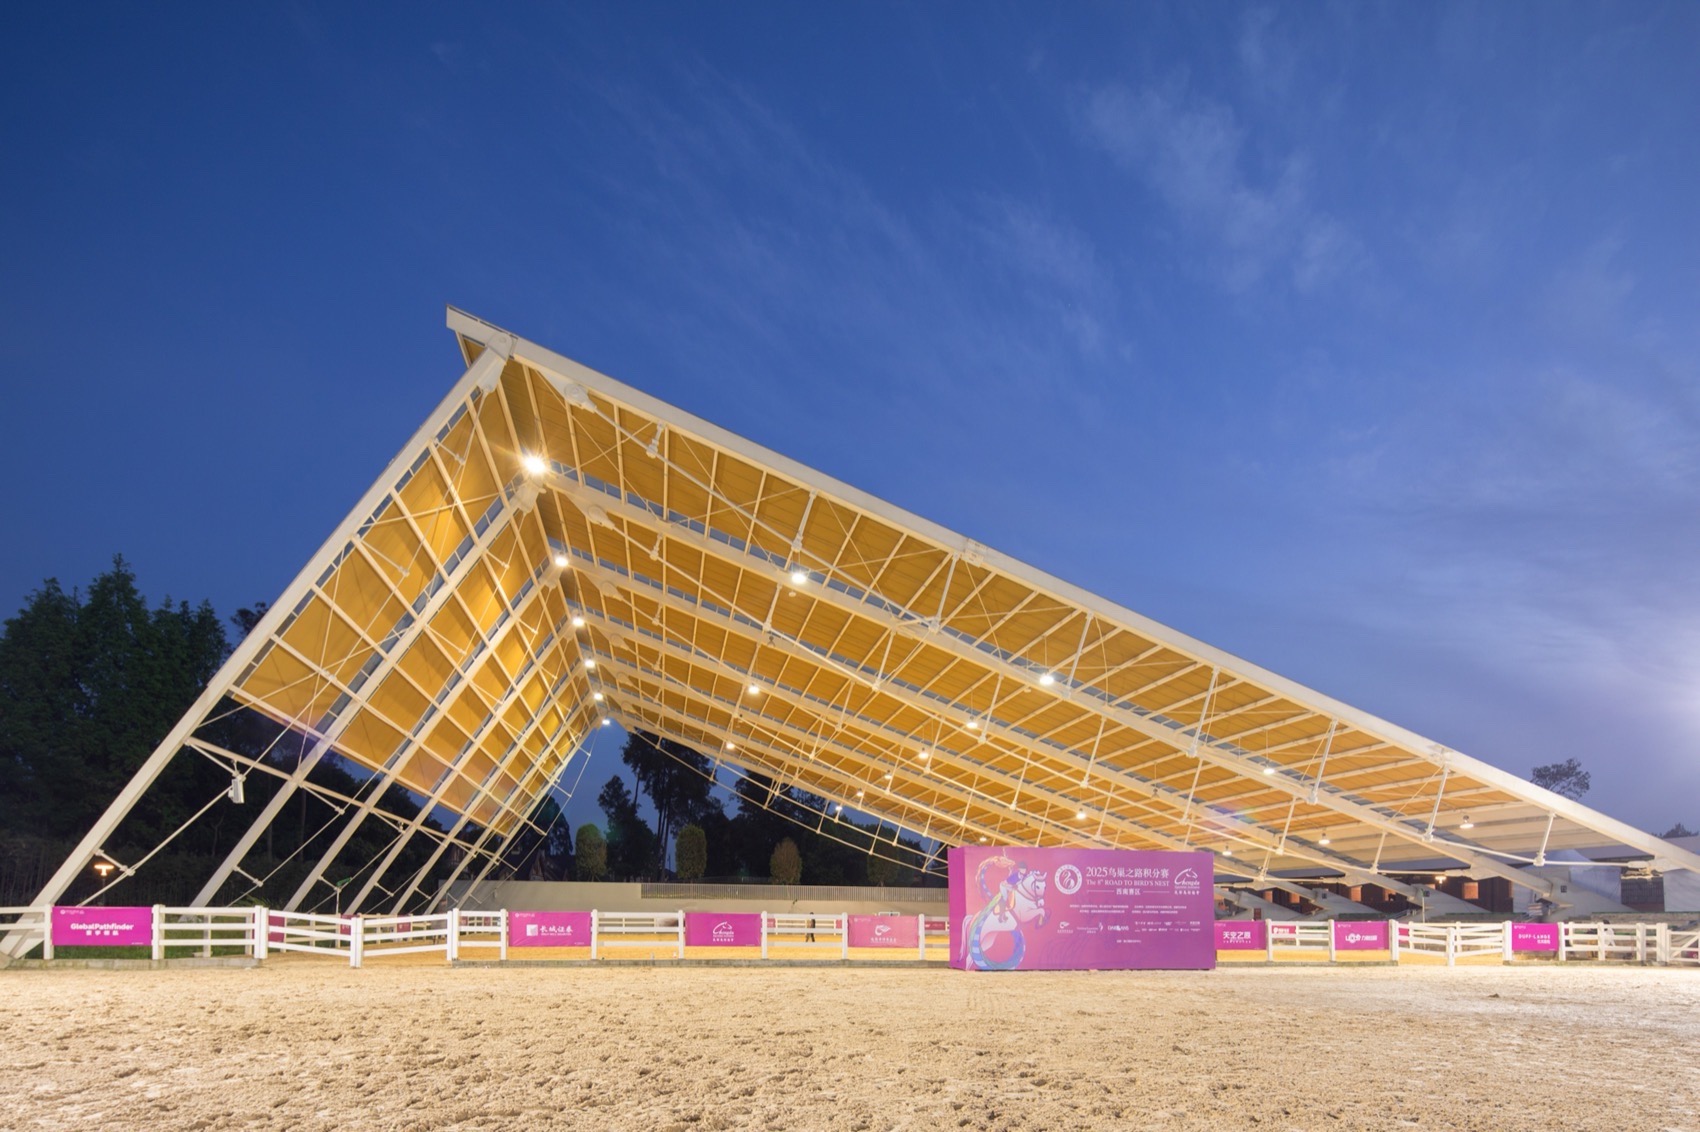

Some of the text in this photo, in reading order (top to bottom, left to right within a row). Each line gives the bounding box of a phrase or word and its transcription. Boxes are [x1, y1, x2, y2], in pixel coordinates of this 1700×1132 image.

[1086, 867, 1170, 879] 2025鸟巢之路积分赛
